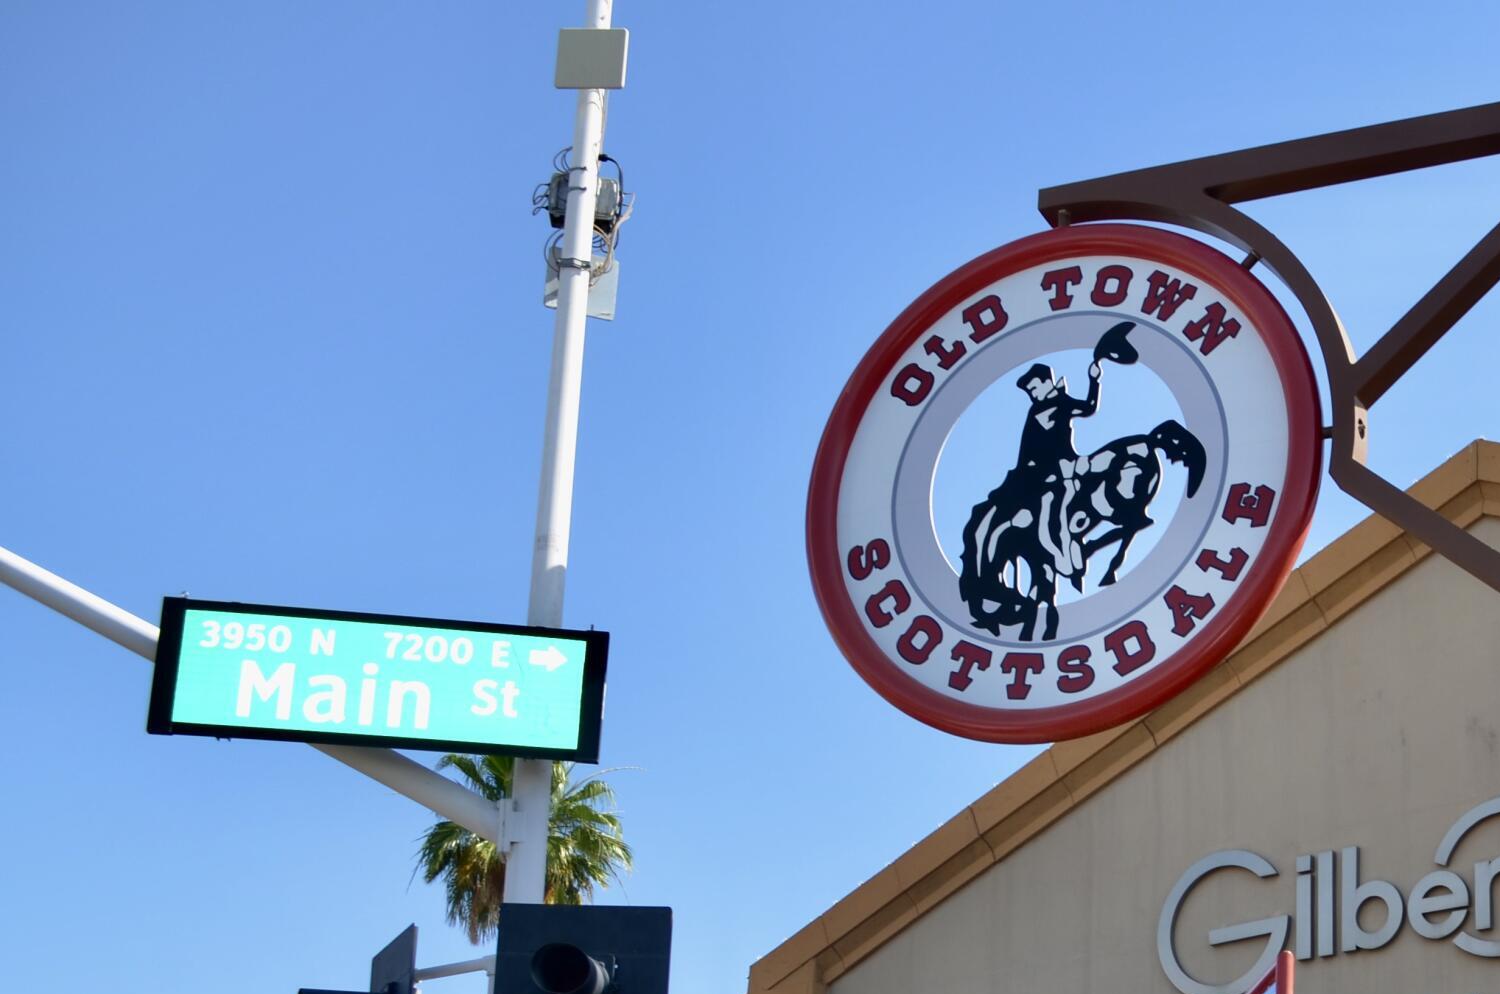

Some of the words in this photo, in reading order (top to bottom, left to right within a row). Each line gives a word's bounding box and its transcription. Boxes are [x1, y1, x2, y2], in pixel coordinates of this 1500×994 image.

[889, 293, 1009, 407] OLD
[1040, 264, 1242, 356] TOWN
[847, 481, 1276, 700] SCOTTSDALE
[200, 620, 292, 653] 3950
[310, 628, 336, 656] N
[383, 631, 474, 665] 7200
[490, 640, 511, 669] E
[235, 659, 431, 730] Main
[470, 678, 520, 718] St
